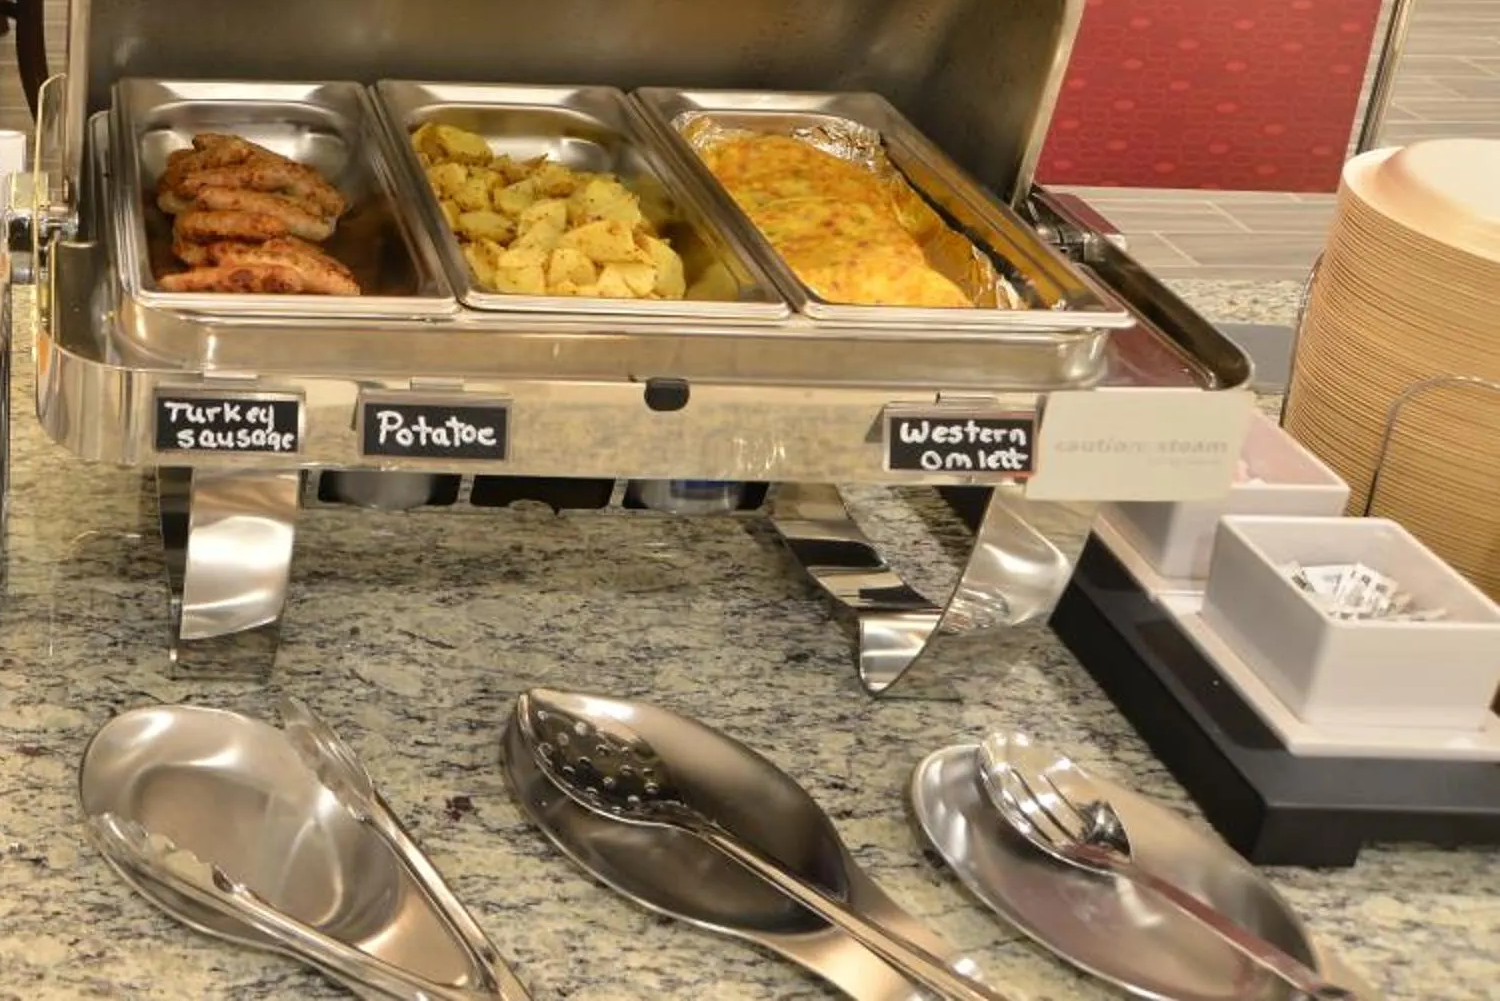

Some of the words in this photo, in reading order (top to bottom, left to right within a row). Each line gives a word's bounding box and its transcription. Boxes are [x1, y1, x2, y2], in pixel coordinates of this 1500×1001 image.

[163, 401, 275, 435] Turkey
[376, 410, 498, 447] Potatoe
[899, 419, 1028, 447] Western
